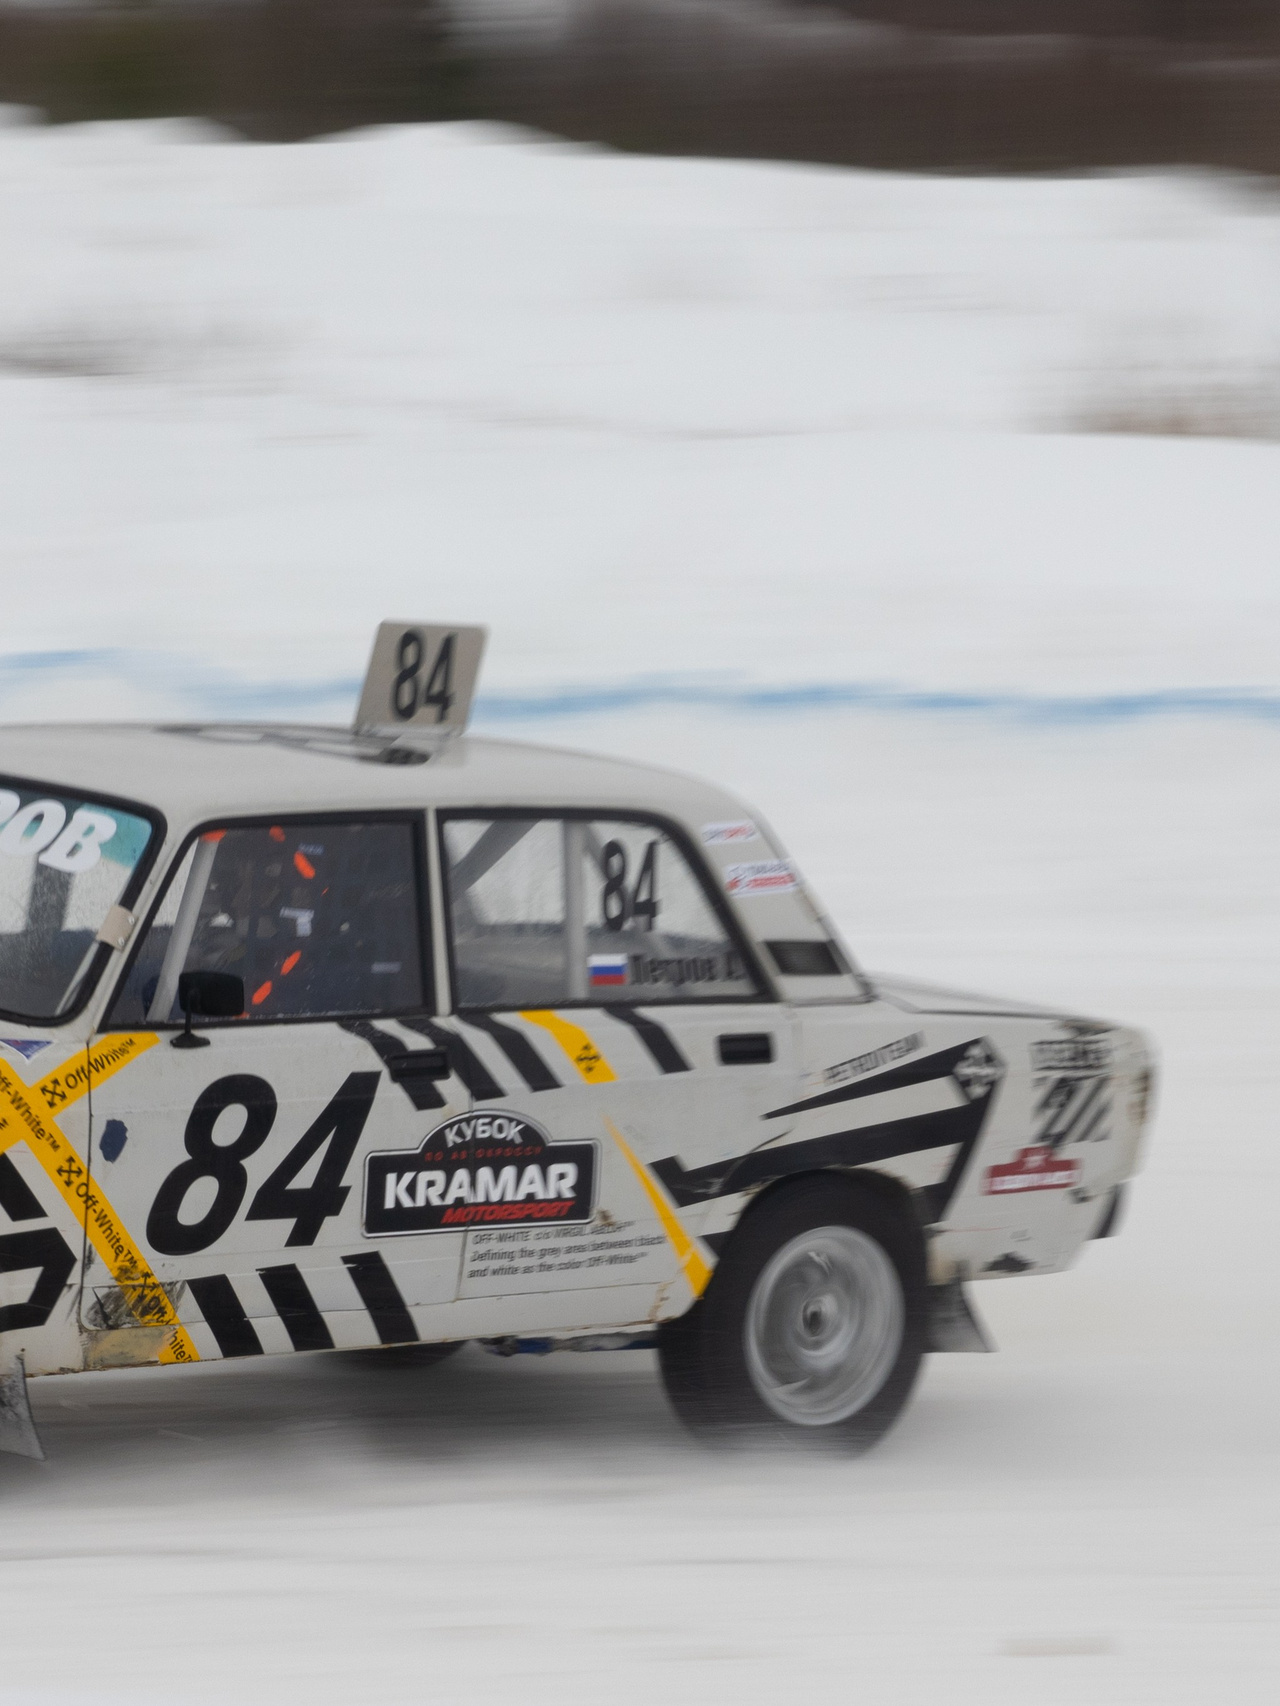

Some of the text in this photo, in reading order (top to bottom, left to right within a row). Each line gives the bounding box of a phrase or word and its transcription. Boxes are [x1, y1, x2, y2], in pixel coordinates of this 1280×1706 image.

[391, 628, 457, 723] 84
[604, 839, 658, 932] 84
[146, 1070, 382, 1256] 84
[444, 1118, 526, 1148] КУБОК
[384, 1162, 578, 1209] KRAMAR
[440, 1201, 576, 1225] MOTORSPORT
